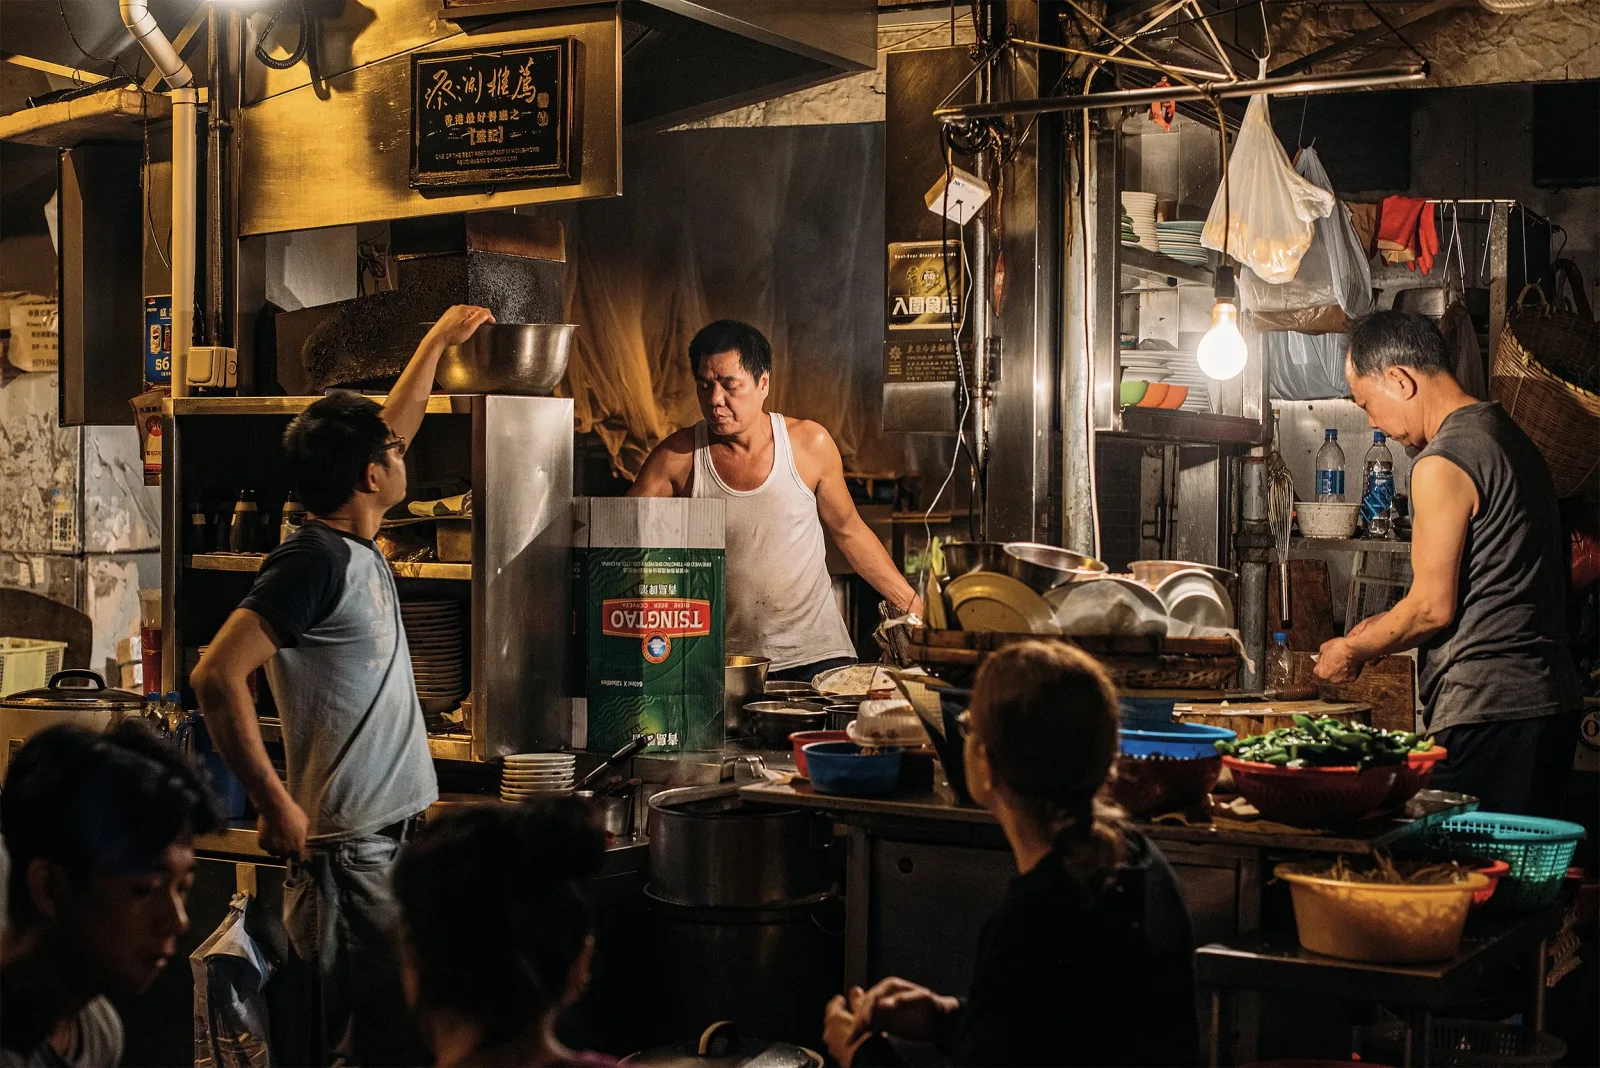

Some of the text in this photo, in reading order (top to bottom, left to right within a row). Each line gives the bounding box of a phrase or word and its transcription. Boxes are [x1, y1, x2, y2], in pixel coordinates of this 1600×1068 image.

[638, 584, 677, 596] 青島啤酒
[610, 610, 703, 629] TSINGTAO
